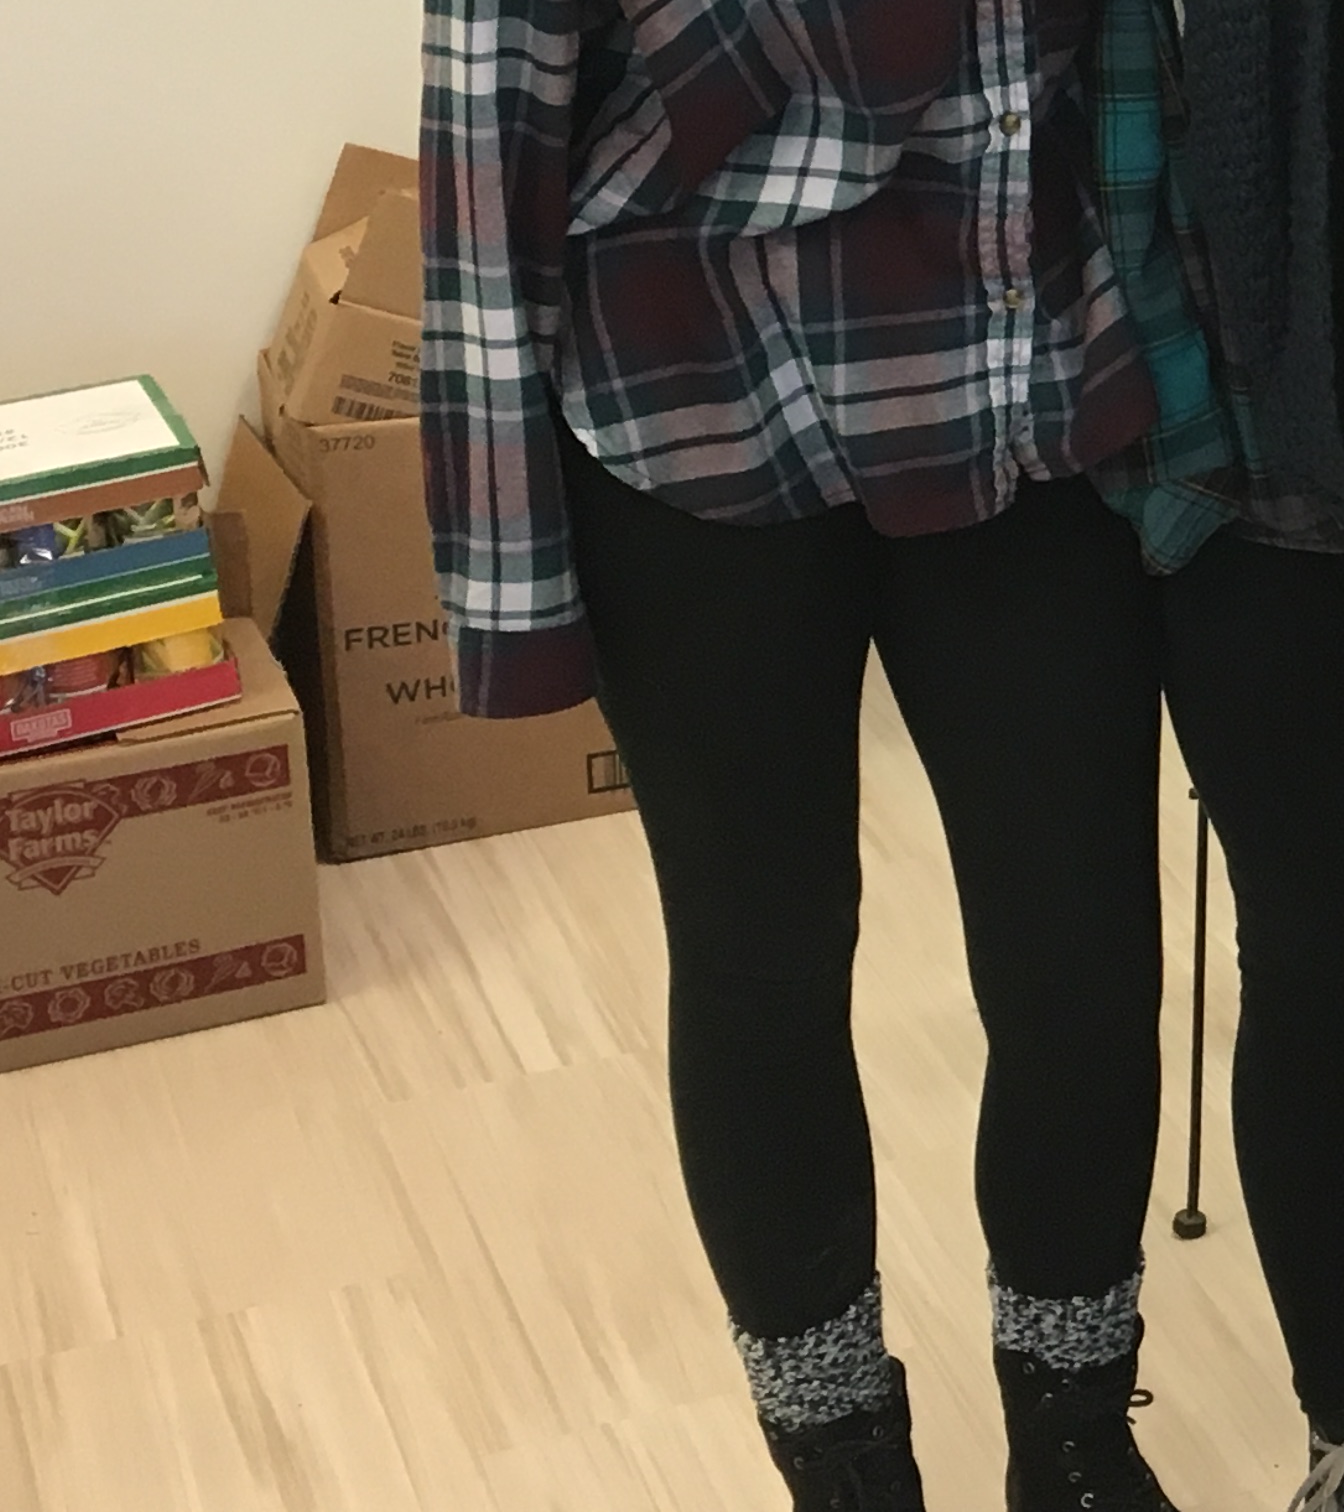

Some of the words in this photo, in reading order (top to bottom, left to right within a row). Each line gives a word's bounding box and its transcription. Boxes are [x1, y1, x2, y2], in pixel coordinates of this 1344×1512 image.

[318, 434, 376, 454] 37720
[344, 619, 449, 652] FREN
[385, 675, 456, 705] WH
[5, 799, 98, 834] Taylor
[8, 828, 101, 862] Farms
[60, 938, 202, 980] VEGETABLES
